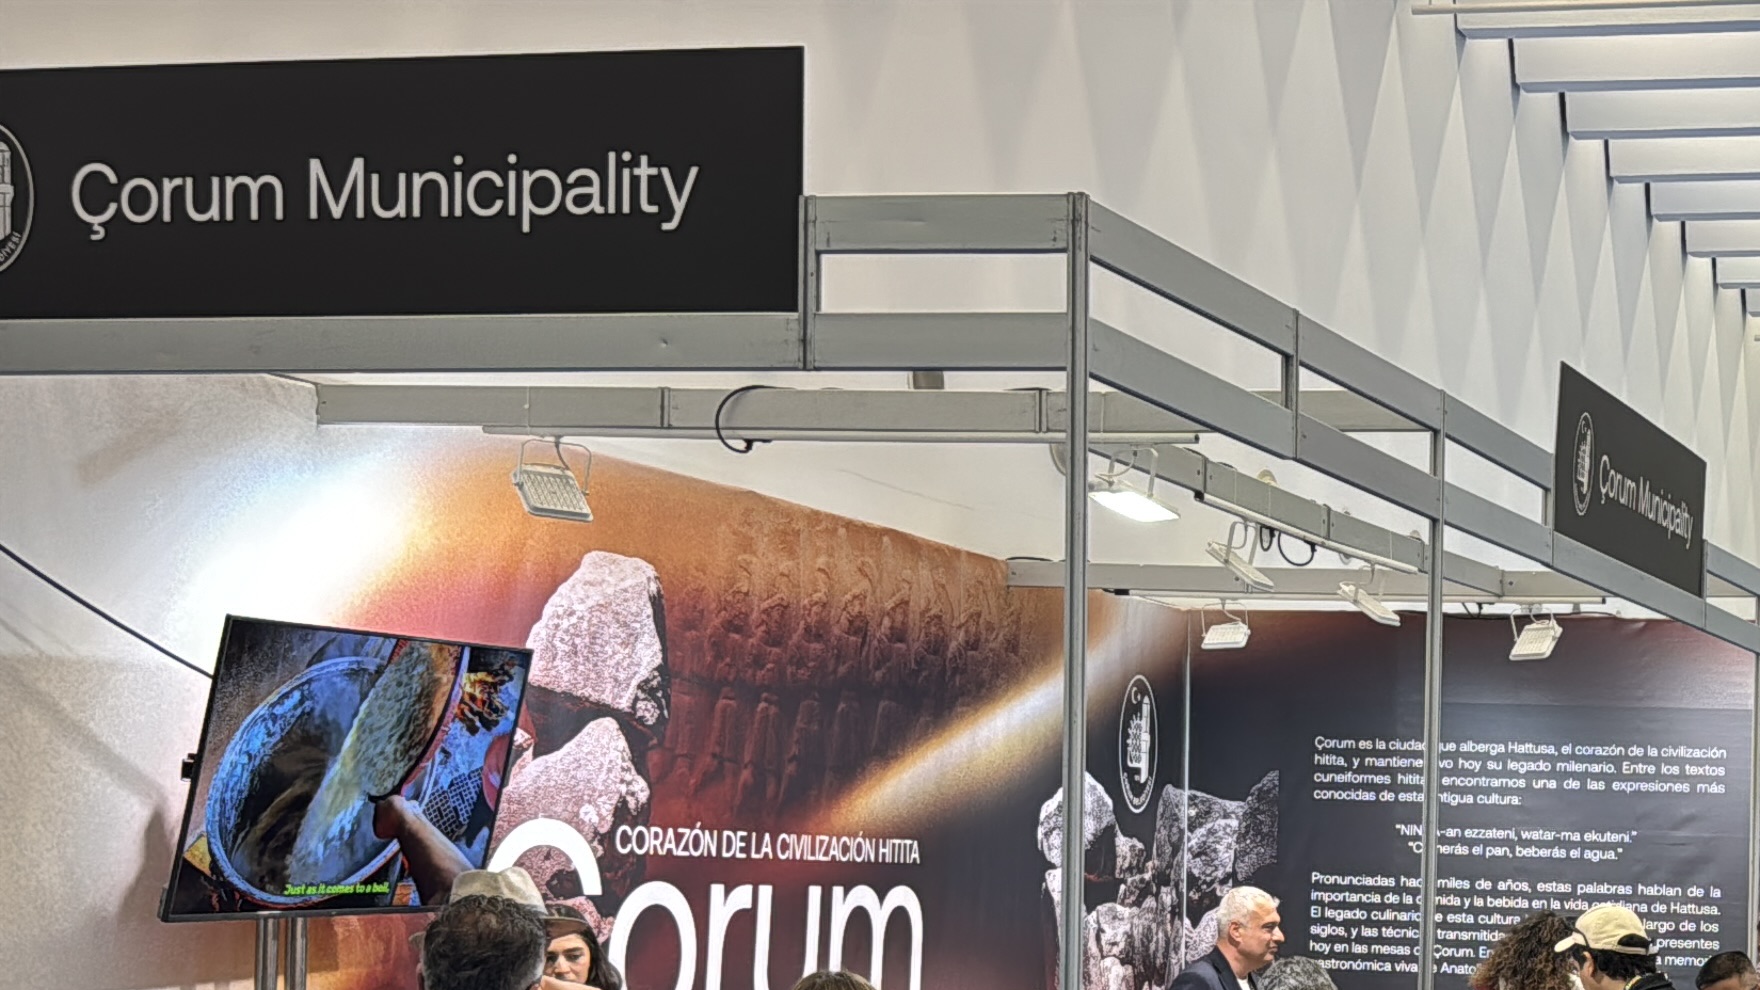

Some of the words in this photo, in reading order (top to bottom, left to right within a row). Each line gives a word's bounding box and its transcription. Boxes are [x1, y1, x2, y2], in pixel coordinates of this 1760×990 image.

[72, 161, 284, 241] Çorum
[309, 152, 698, 232] Municipality
[1600, 454, 1637, 511] Çorum
[1638, 476, 1693, 550] Municipality
[1315, 736, 1355, 750] Çorum
[1359, 740, 1373, 750] es
[1376, 738, 1386, 750] la
[1460, 740, 1505, 755] alberga
[1508, 742, 1558, 757] Hattusa,
[1561, 743, 1572, 755] el
[1575, 744, 1625, 757] corazón
[1628, 744, 1644, 757] de
[1648, 745, 1658, 758] la
[1661, 746, 1727, 759] civilización
[1314, 754, 1347, 767] hitita,
[1352, 757, 1360, 769] y
[1365, 756, 1423, 768] mantiene
[1438, 759, 1453, 769] vo
[1459, 758, 1481, 772] hoy
[1487, 760, 1502, 771] su
[1508, 759, 1551, 775] legado
[1557, 761, 1617, 775] milenario.
[1622, 761, 1656, 775] Entre
[1662, 763, 1680, 776] los
[1685, 763, 1726, 777] textos
[1314, 771, 1391, 785] cuneiformes
[1398, 773, 1425, 786] hitita
[1442, 775, 1526, 789] encontramos
[1533, 780, 1557, 790] una
[1564, 778, 1581, 790] de
[1587, 778, 1605, 791] las
[1612, 780, 1690, 795] expresiones
[1697, 781, 1726, 794] más
[1314, 788, 1376, 801] conocidas
[1379, 789, 1395, 802] de
[1398, 790, 1424, 802] esta
[1438, 792, 1474, 806] ntigua
[1477, 793, 1522, 806] cultura:
[616, 822, 717, 857] CORAZÓN
[722, 831, 746, 858] DE
[752, 832, 773, 860] LA
[776, 831, 875, 863] CIVILIZACIÓN
[878, 839, 920, 864] HITITA
[1465, 827, 1518, 841] ezzateni,
[1521, 829, 1581, 842] watar-ma
[1472, 844, 1483, 856] el
[1486, 846, 1513, 860] pan,
[1516, 845, 1567, 860] beberás
[1570, 846, 1581, 859] el
[285, 884, 305, 895] Just
[306, 885, 317, 894] as
[318, 883, 326, 894] it
[326, 884, 354, 894] comes
[355, 881, 365, 893] to
[366, 885, 373, 893] a
[1311, 872, 1396, 886] Pronunciadas
[1400, 875, 1423, 888] hac
[1437, 876, 1471, 890] miles
[1475, 877, 1492, 890] de
[1497, 878, 1532, 893] años,
[1537, 881, 1572, 893] estas
[1577, 882, 1633, 896] palabras
[1638, 883, 1682, 897] hablan
[1687, 884, 1705, 898] de
[1710, 885, 1722, 899] la
[1311, 890, 1381, 905] importancia
[1384, 892, 1400, 905] de
[1403, 892, 1414, 905] la
[1463, 897, 1471, 909] y
[1474, 895, 1484, 908] la
[1487, 895, 1529, 910] bebida
[1532, 899, 1548, 910] en
[1551, 897, 1561, 911] la
[1564, 898, 1589, 911] vida
[1651, 901, 1668, 914] de
[1670, 902, 1721, 916] Hattusa.
[1311, 906, 1321, 919] El
[1324, 907, 1367, 922] legado
[1434, 912, 1444, 923] e
[1447, 913, 1475, 924] esta
[1679, 919, 1697, 932] de
[1700, 920, 1720, 933] los
[1310, 924, 1347, 938] siglos,
[1351, 927, 1359, 940] y
[1361, 925, 1379, 938] las
[1382, 925, 1420, 939] técnic
[1656, 939, 1720, 952] presentes
[1310, 940, 1330, 955] hoy
[1334, 942, 1349, 953] en
[1352, 941, 1368, 954] las
[1371, 944, 1411, 956] mesas
[1433, 944, 1476, 959] Çorum.
[1317, 959, 1392, 972] astronómica
[1395, 960, 1418, 973] viva
